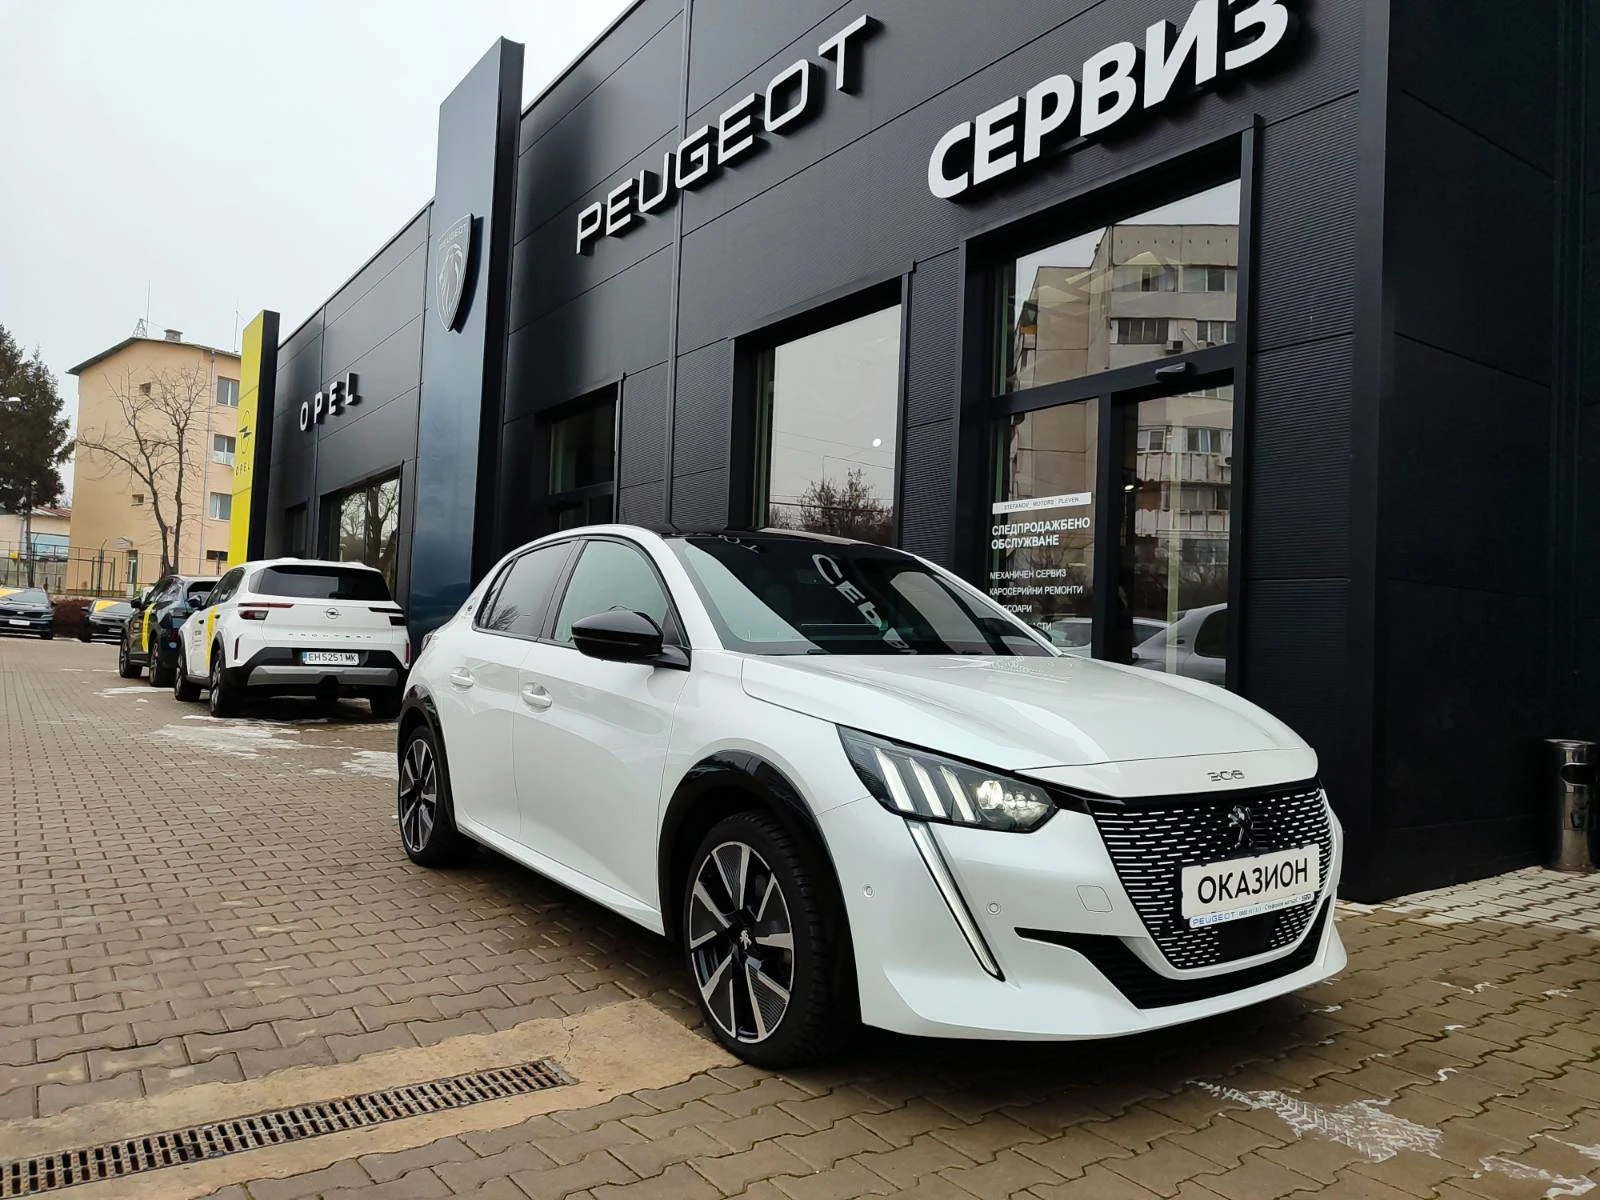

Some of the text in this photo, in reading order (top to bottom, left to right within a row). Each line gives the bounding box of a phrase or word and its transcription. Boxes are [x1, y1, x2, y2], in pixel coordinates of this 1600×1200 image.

[927, 0, 1290, 199] СЕРВИЗ
[575, 14, 874, 254] PEUGEOT
[299, 372, 357, 432] OPEL
[235, 461, 251, 477] OPEL
[1058, 497, 1079, 505] PLEVEN
[991, 518, 1090, 536] СЛЕДПРОДАЖБЕНО
[991, 535, 1060, 549] ОБСЛУЖВАНЕ
[989, 569, 1067, 580] МЕХАНИЧЕН СЕРВИЗ
[989, 585, 1083, 596] КАРОСЕРИЙНИ РЕМОНТИ
[1002, 604, 1032, 613] ЕСОАРИ
[1197, 858, 1308, 904] ОКАЗИОН
[1191, 911, 1236, 925] PEUGEOT
